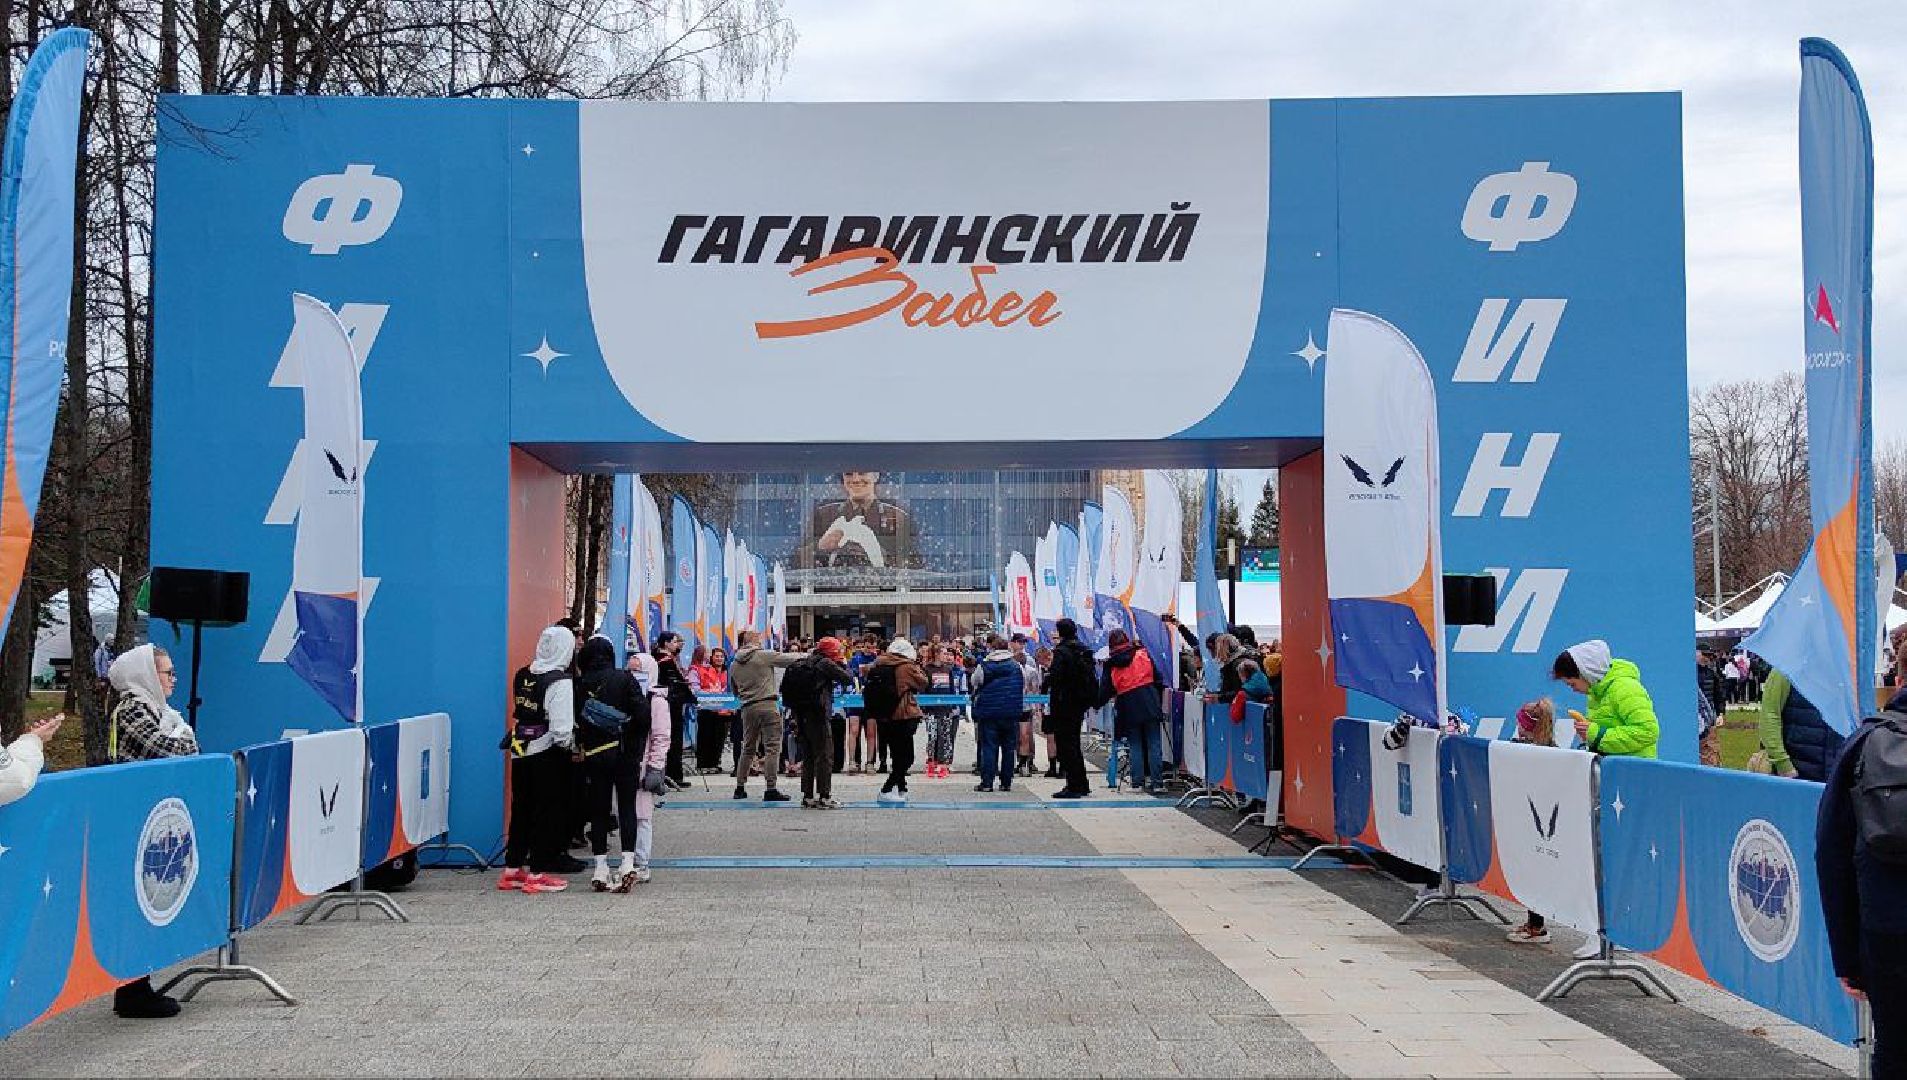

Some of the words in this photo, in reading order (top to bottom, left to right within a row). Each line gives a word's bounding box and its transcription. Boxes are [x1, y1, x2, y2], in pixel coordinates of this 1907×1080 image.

[657, 202, 1201, 263] ГАГАРИНСКИЙ
[754, 247, 1063, 338] Забег
[1451, 161, 1579, 745] ФИНИ
